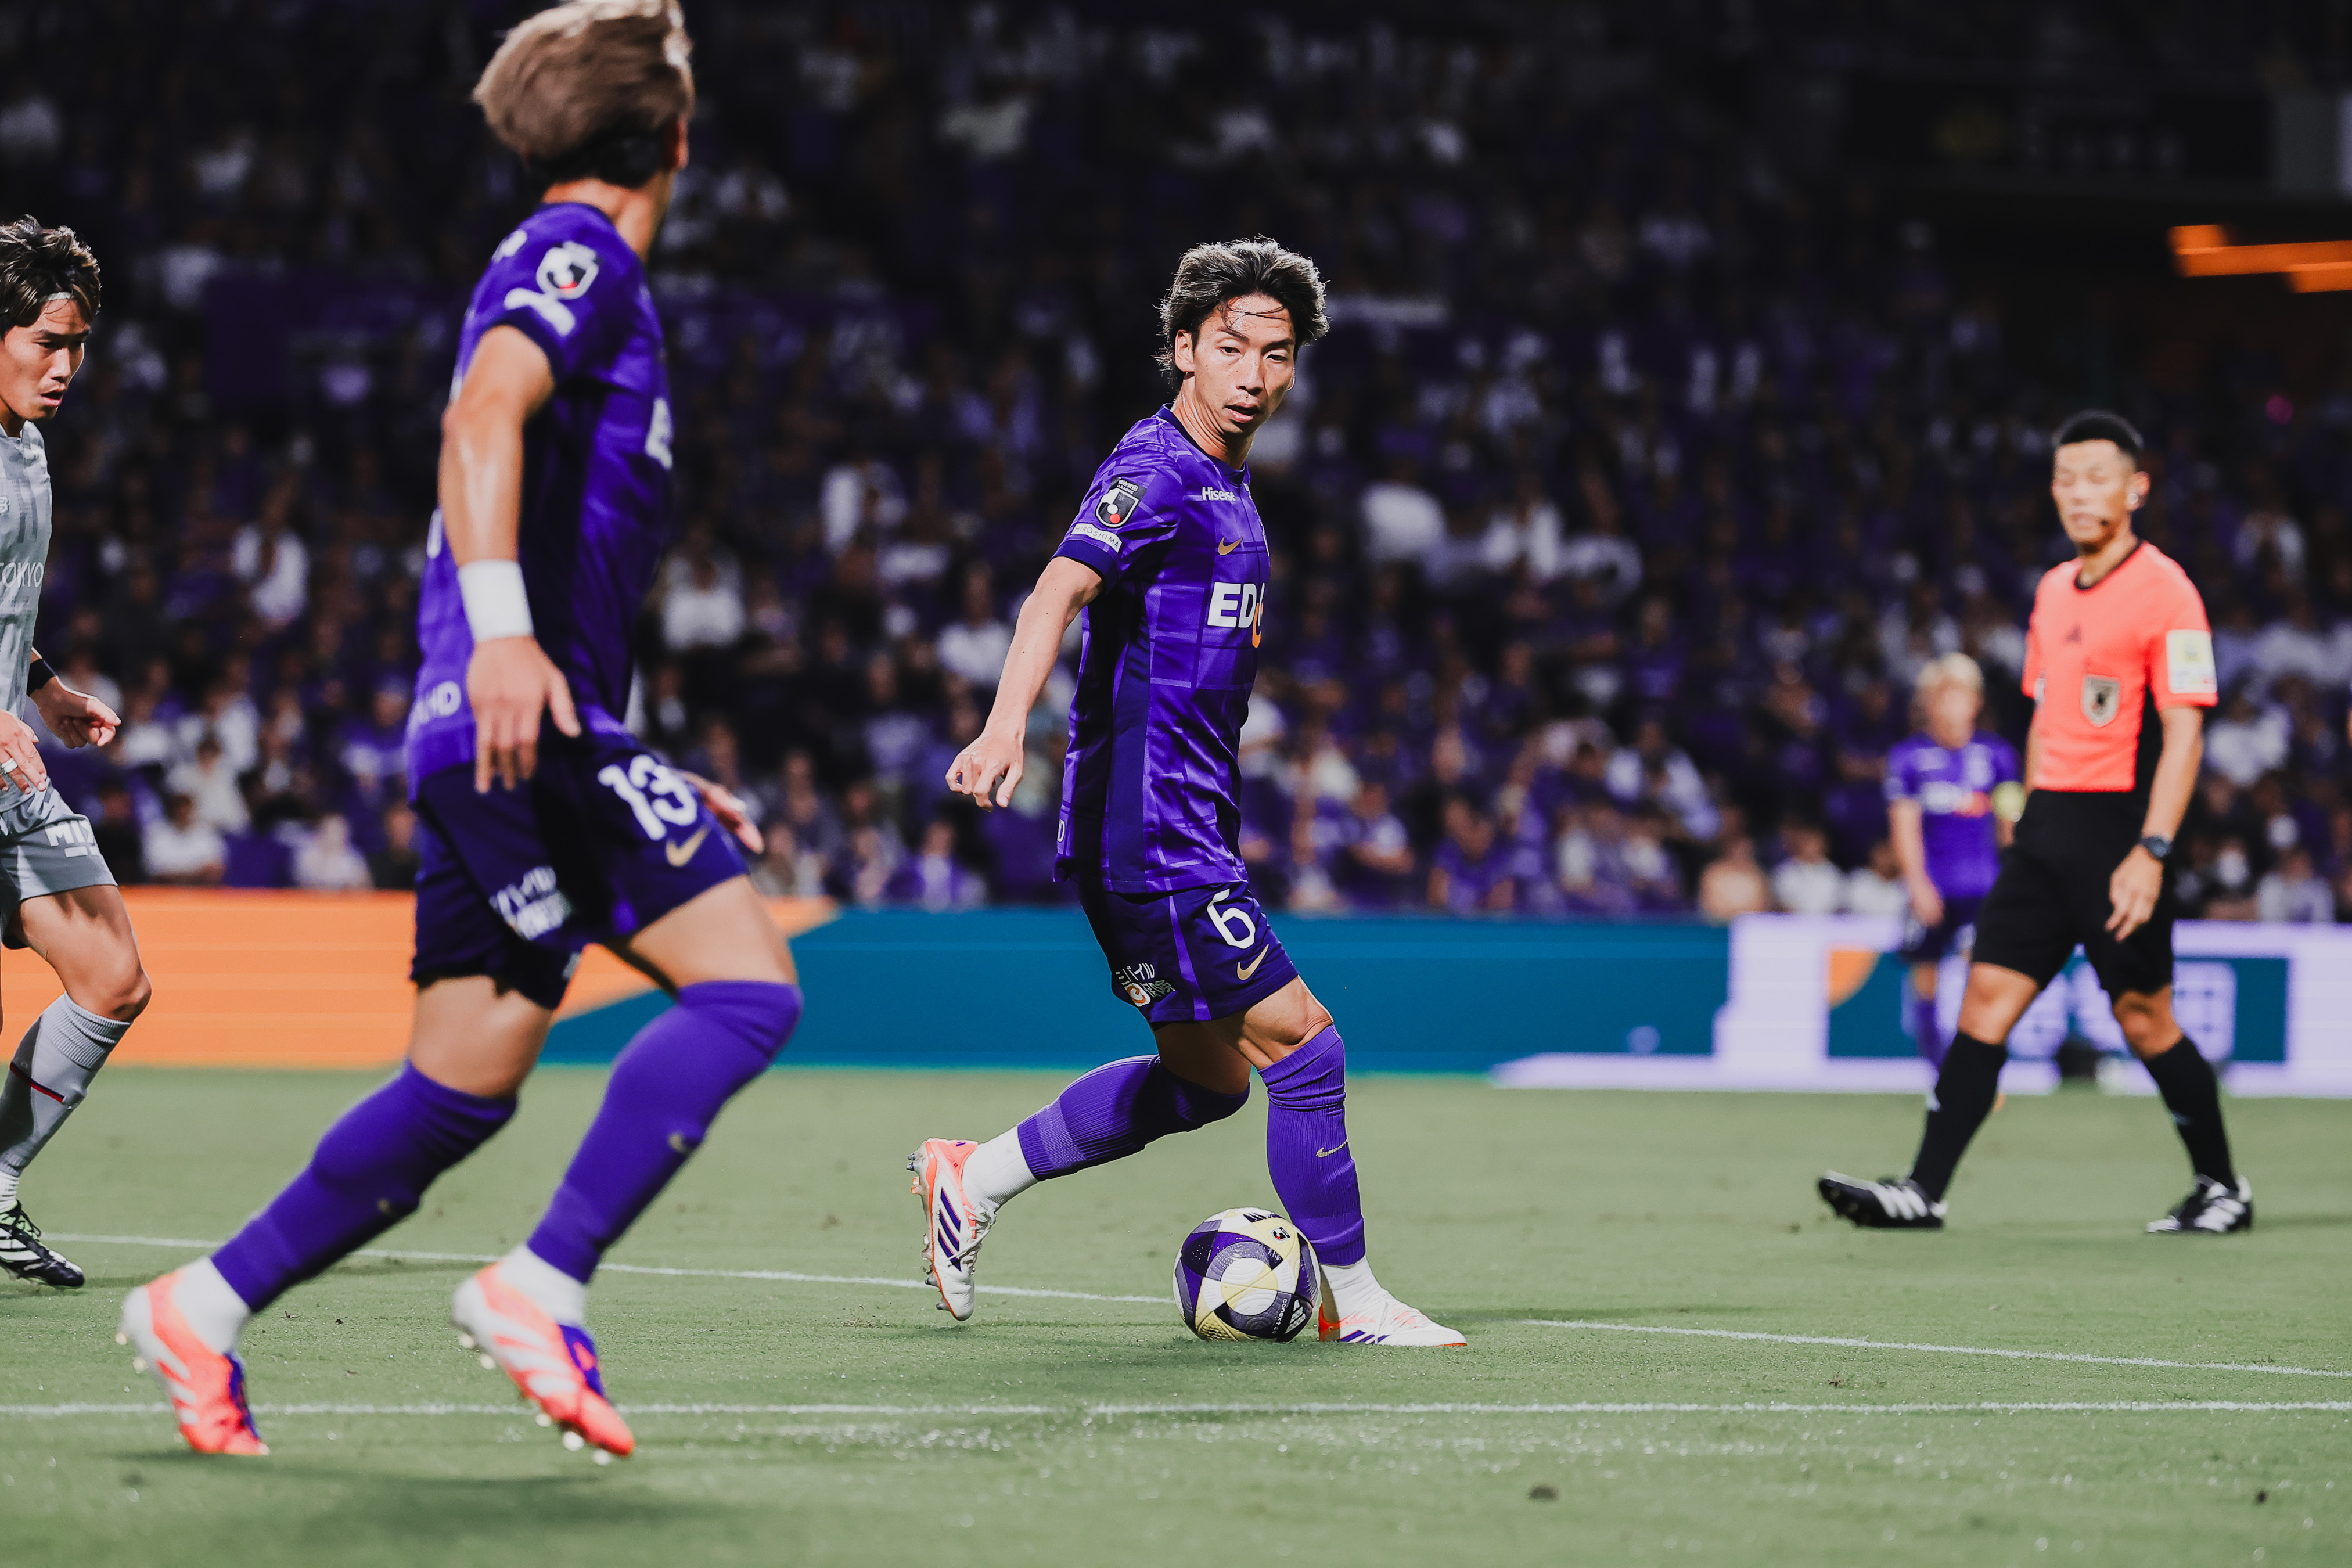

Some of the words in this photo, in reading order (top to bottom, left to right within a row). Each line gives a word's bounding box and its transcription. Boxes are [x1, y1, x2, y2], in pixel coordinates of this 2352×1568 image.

[1074, 526, 1119, 549] HIROSHIMA
[0, 562, 44, 588] OKYO
[598, 753, 697, 841] 13
[1206, 888, 1256, 950] 6
